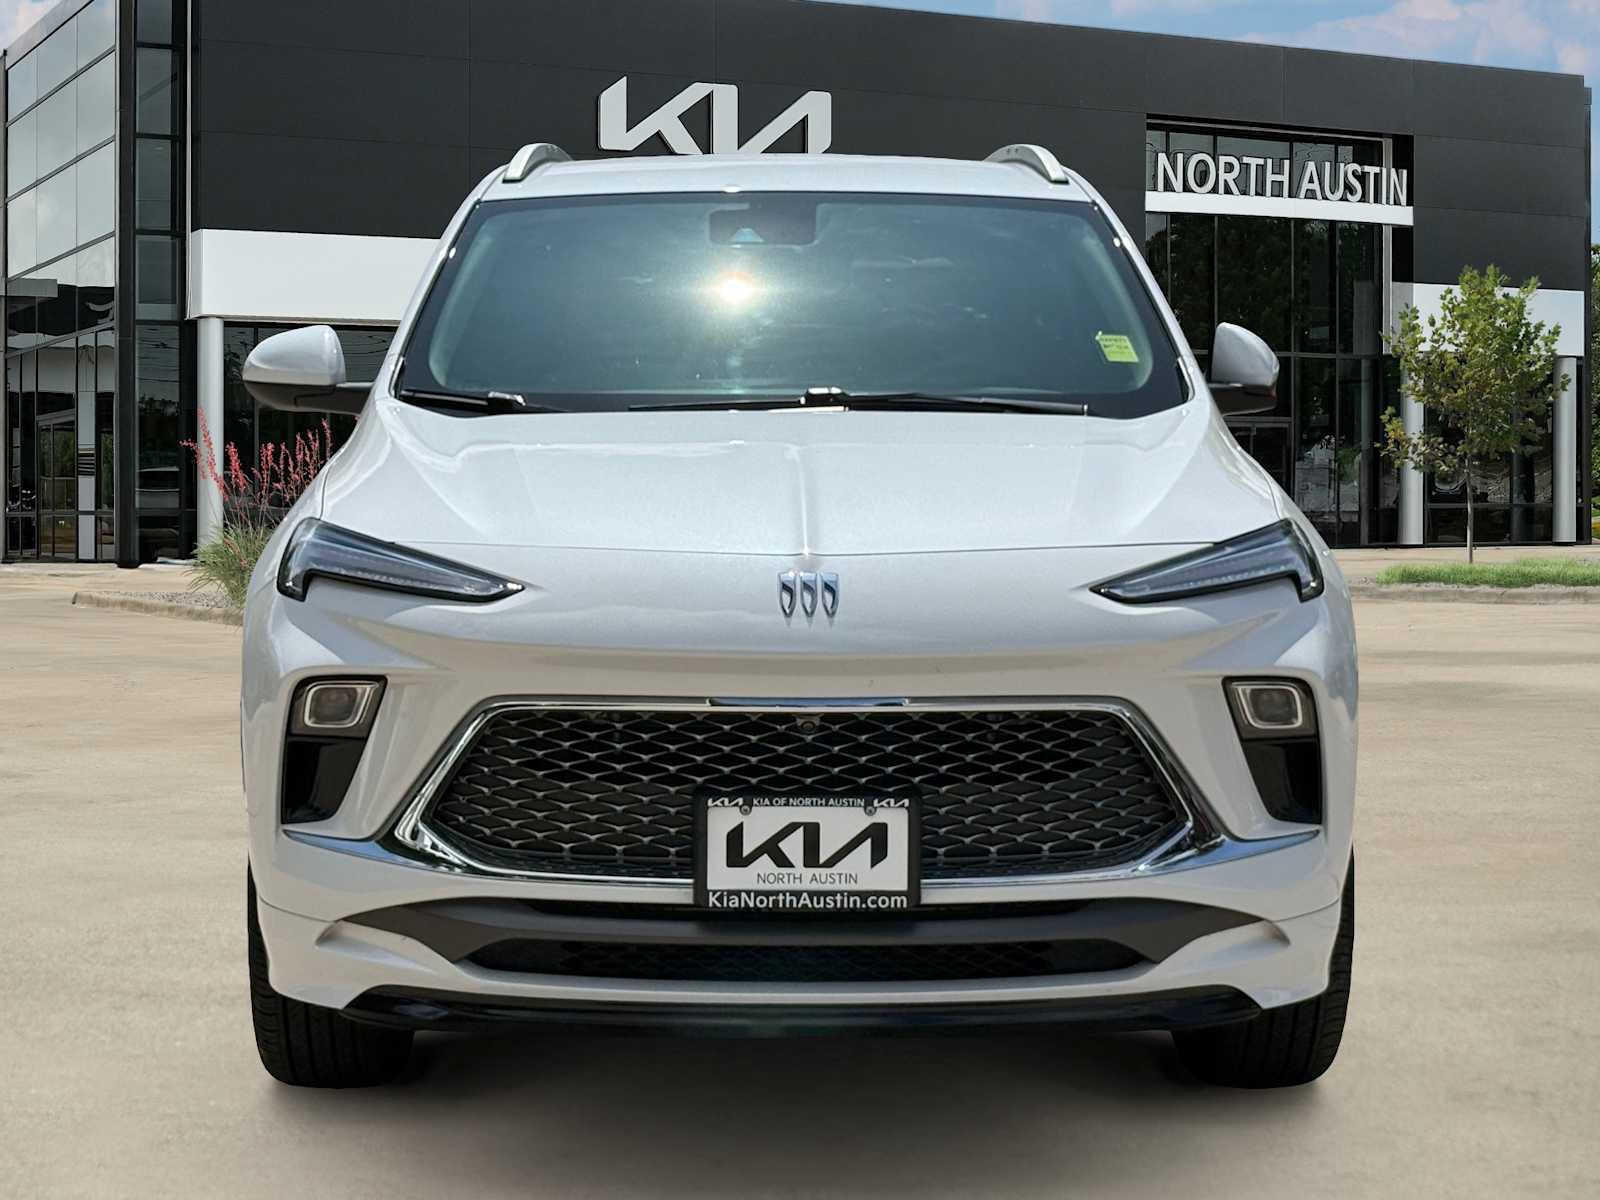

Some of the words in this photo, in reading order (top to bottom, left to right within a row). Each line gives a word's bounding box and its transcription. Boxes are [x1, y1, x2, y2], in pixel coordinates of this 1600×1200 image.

[598, 76, 832, 155] KIA
[1157, 152, 1290, 198] NORTH
[1299, 160, 1408, 206] AUSTIN
[753, 798, 771, 807] KIA
[773, 798, 787, 807] OF
[789, 798, 826, 807] NORTH
[829, 798, 865, 807] AUSTIN
[726, 821, 888, 869] KIA
[757, 872, 802, 884] NORTH
[809, 872, 858, 884] AUSTIN
[708, 891, 908, 909] KiaNorthAustin.com
